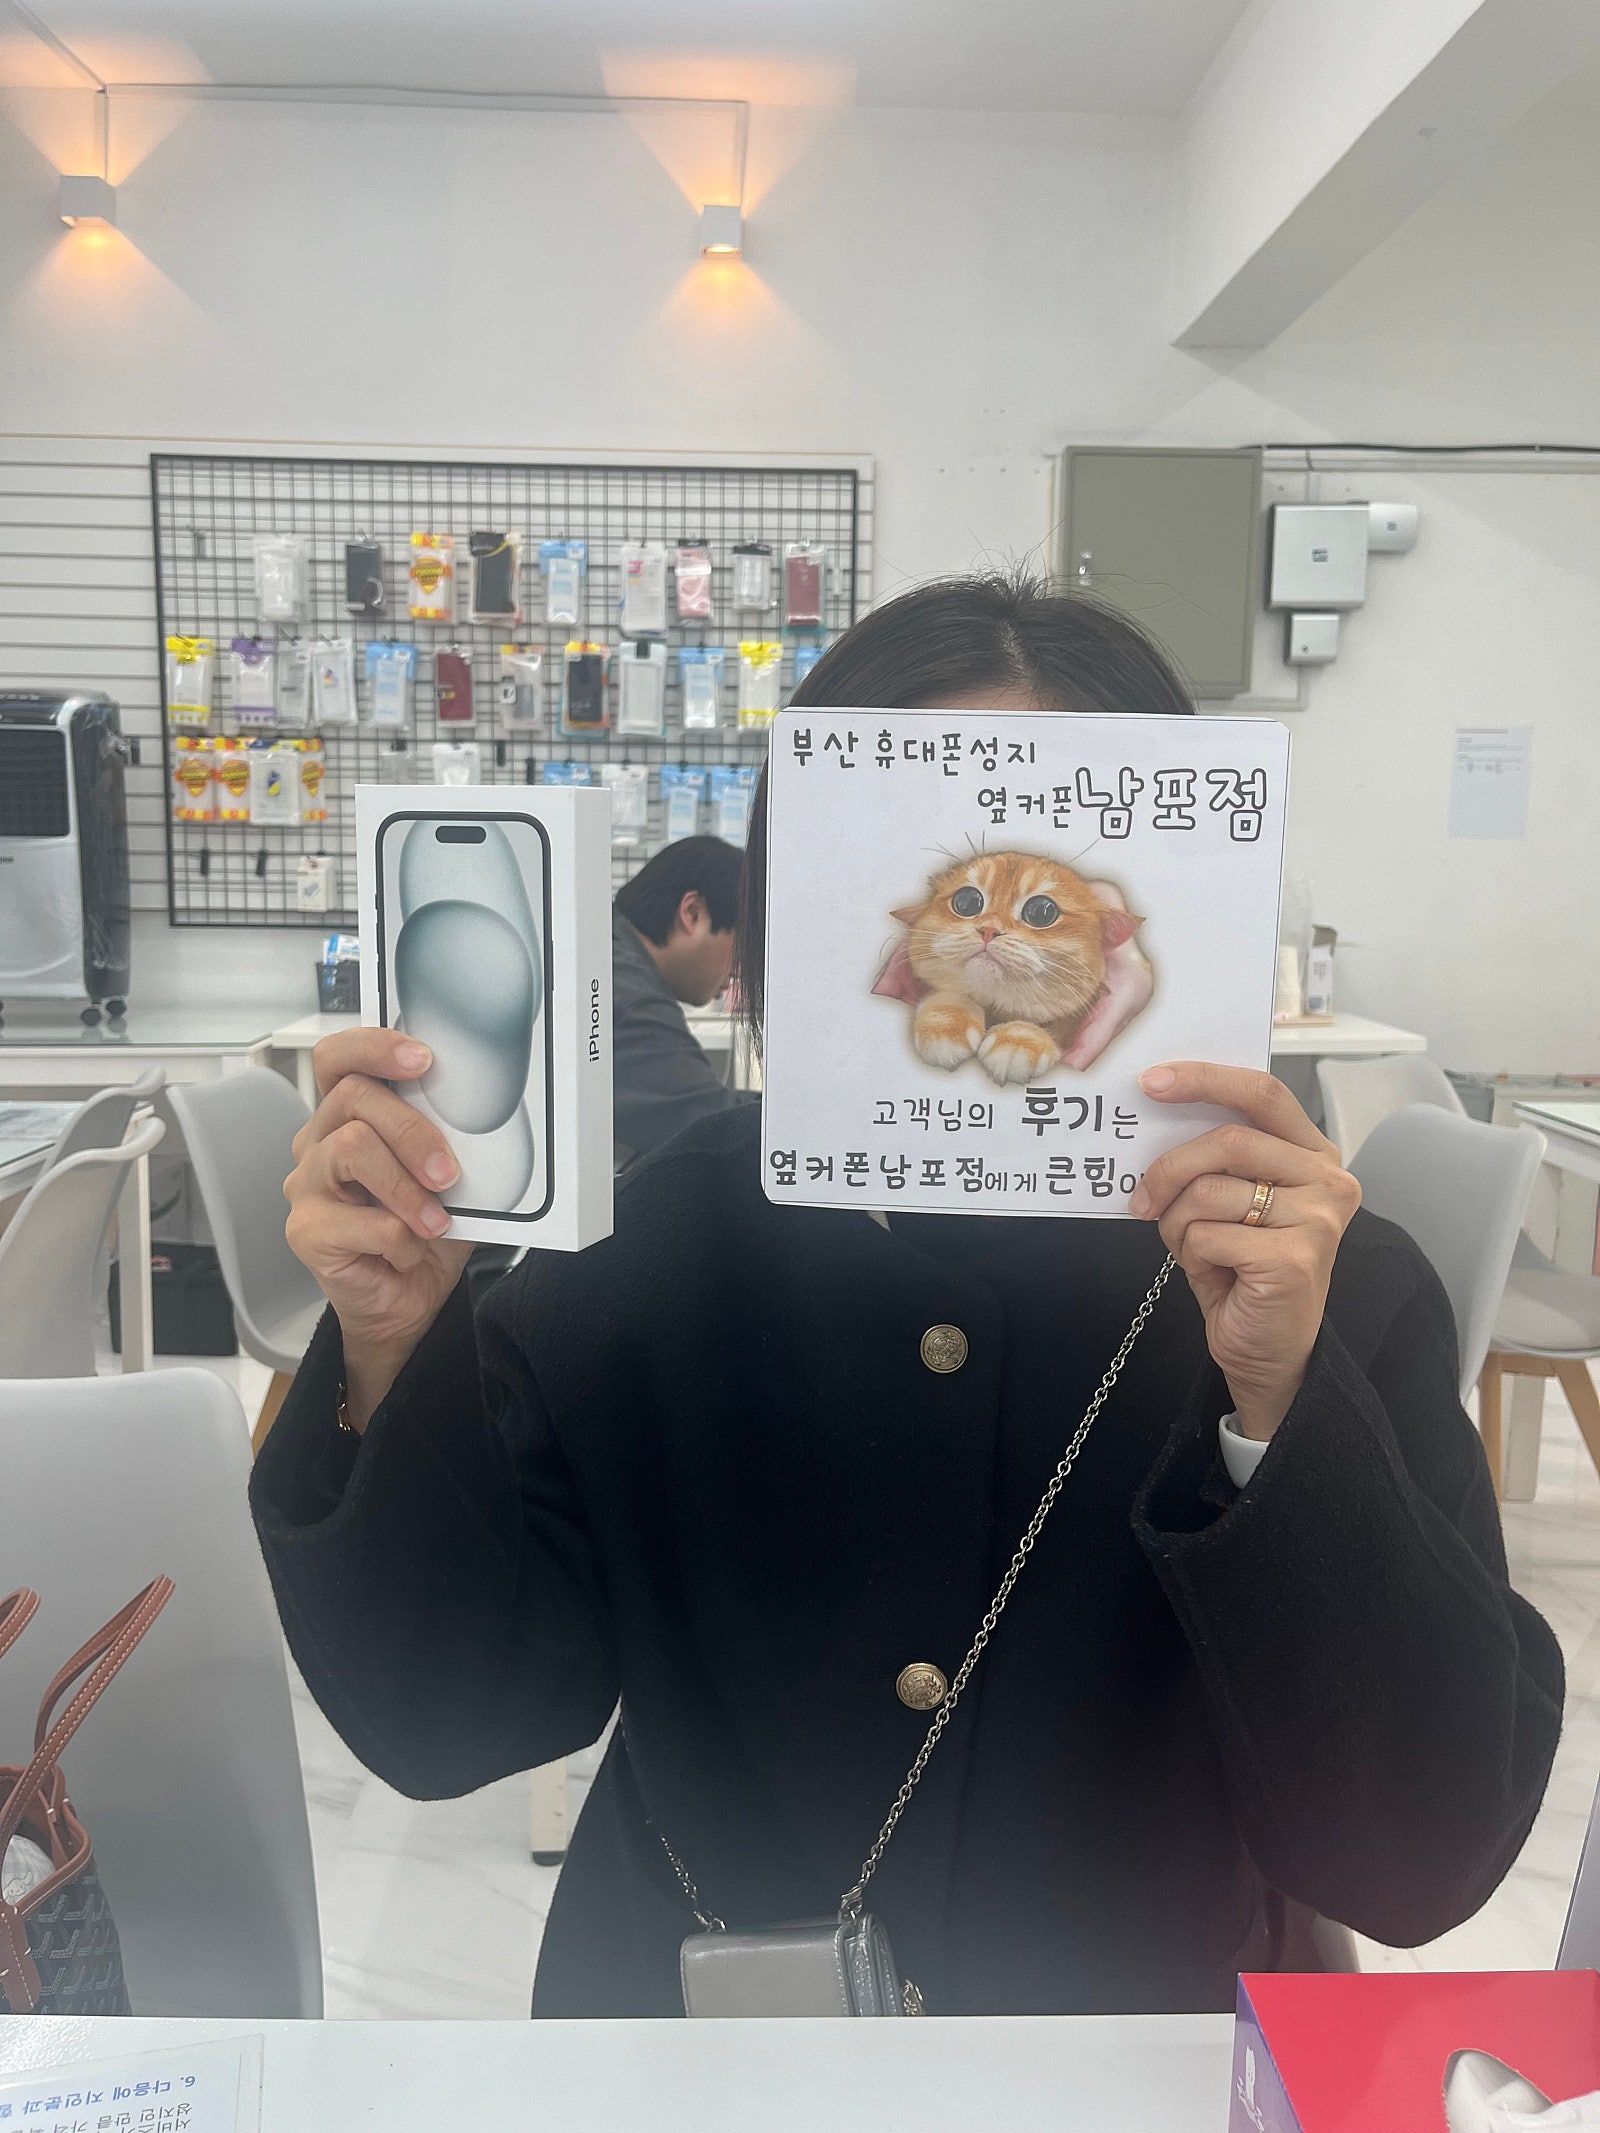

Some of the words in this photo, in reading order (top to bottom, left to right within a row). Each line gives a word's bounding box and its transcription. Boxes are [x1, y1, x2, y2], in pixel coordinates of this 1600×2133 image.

[793, 728, 859, 769] 부산
[875, 729, 1036, 777] 휴대폰성지
[589, 978, 600, 1062] iPhone
[872, 1097, 993, 1132] 고객님의
[1020, 1085, 1139, 1140] 후기는
[112, 2080, 171, 2101] 다음에
[180, 2075, 196, 2088] 6.
[23, 2091, 104, 2115] 지인분과
[140, 2103, 193, 2122] 성지인
[97, 2112, 131, 2129] 만큼
